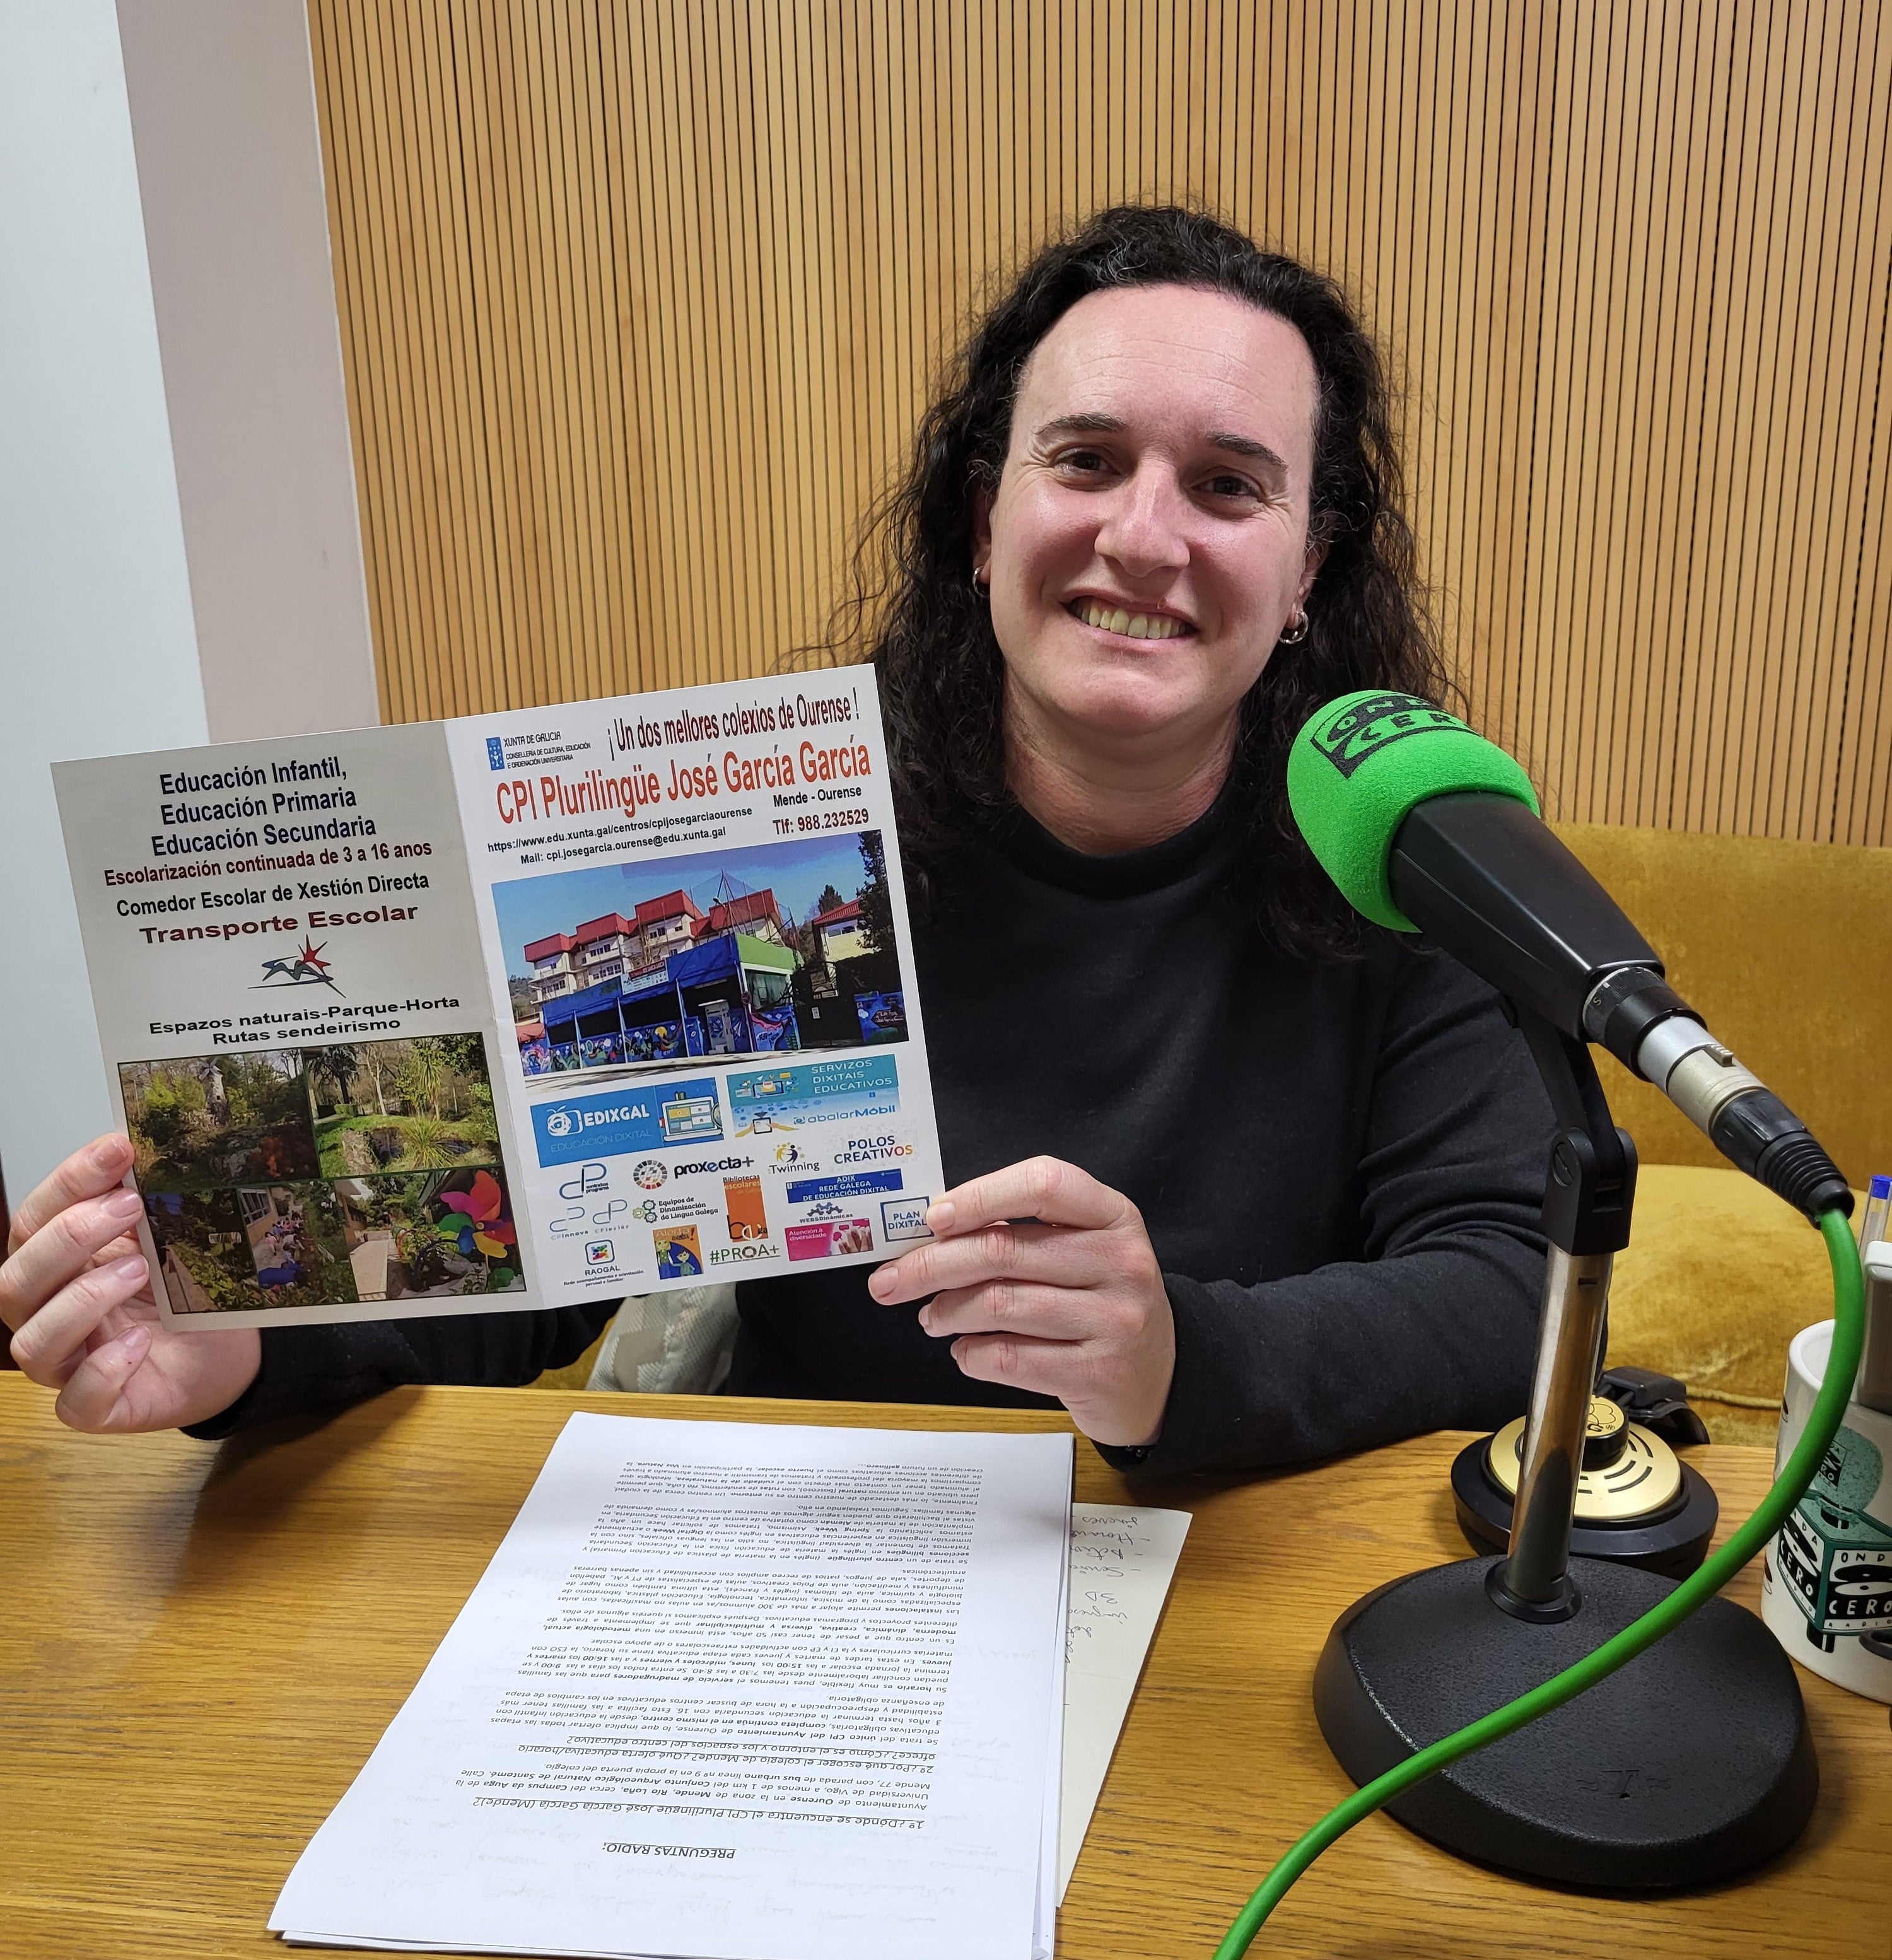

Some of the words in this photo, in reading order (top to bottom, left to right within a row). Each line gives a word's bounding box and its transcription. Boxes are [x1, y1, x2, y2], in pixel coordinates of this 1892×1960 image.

[614, 718, 635, 752] Un
[637, 715, 662, 749] dos
[663, 709, 720, 745] mellores
[722, 700, 776, 737] colexios
[778, 696, 795, 730] de
[797, 694, 851, 727] Ourense
[503, 735, 526, 747] XUNTA
[526, 734, 535, 744] DE
[535, 731, 561, 743] GALICIA
[565, 741, 592, 752] EDUCACIÓN
[160, 765, 267, 795] Educación
[271, 755, 347, 783] Infantil,
[496, 779, 537, 824] CPI
[540, 764, 661, 819] Plurilingüe
[667, 753, 718, 801] José
[723, 744, 796, 793] García
[799, 733, 872, 783] García
[773, 791, 809, 807] Mende
[817, 786, 862, 802] Ourense
[160, 796, 268, 825] Educación
[272, 786, 357, 814] Primaria
[772, 818, 794, 835] Tlf:
[797, 808, 869, 832] 988.232529
[151, 827, 259, 856] Educación
[263, 816, 377, 845] Secundaria
[520, 852, 544, 865] Mail:
[104, 860, 222, 887] Escolarización
[226, 850, 316, 874] continuada
[319, 848, 339, 865] de
[342, 846, 353, 863] 3
[357, 848, 368, 861] a
[371, 843, 390, 860] 16
[394, 843, 432, 858] anos
[117, 894, 196, 917] Comedor
[201, 887, 267, 909] Escolar
[272, 884, 293, 902] de
[296, 878, 363, 900] Xestión
[367, 872, 429, 893] Directa
[139, 915, 298, 944] Transporte
[308, 905, 418, 928] Escolar
[149, 1018, 233, 1035] Espazos
[239, 996, 460, 1027] naturais-Parque-Horta
[213, 1031, 271, 1045] Rutas
[277, 1020, 400, 1039] sendeirismo
[811, 1059, 872, 1074] SERVIZOS
[813, 1071, 864, 1084] DIXITAIS
[814, 1077, 892, 1094] EDUCATIVOS
[584, 1104, 650, 1127] EDIXGAL
[808, 1105, 896, 1123] abalarMóbil
[551, 1135, 613, 1153] EDUCACIÓN
[612, 1129, 651, 1144] DIXITAL
[848, 1135, 896, 1151] POLOS
[834, 1145, 913, 1164] CREATIVOS
[768, 1161, 820, 1174] Twinning
[723, 1174, 760, 1183] Bibliotecas
[836, 1175, 856, 1183] ADIX
[819, 1184, 839, 1193] REDE
[839, 1180, 872, 1189] GALEGA
[814, 1188, 858, 1200] EDUCACIÓN
[860, 1186, 889, 1194] DIXITAL
[658, 1198, 686, 1207] Equipos
[659, 1201, 706, 1213] Dinamización
[893, 1210, 920, 1221] PLAN
[585, 1265, 621, 1276] RAOGAL
[1841, 1552, 1885, 1563] OND
[566, 1735, 628, 1746] educativo?
[631, 1738, 668, 1746] centro
[670, 1739, 688, 1749] del
[691, 1739, 739, 1749] espacios
[761, 1742, 768, 1751] y
[518, 1744, 619, 1757] educativa/horario
[742, 1742, 758, 1753] los
[771, 1744, 816, 1754] entorno
[819, 1747, 830, 1756] el
[849, 1748, 889, 1758] ¿Cómo
[622, 1749, 656, 1759] oferta
[658, 1751, 689, 1760] ¿Qué
[691, 1752, 739, 1763] Mende?
[742, 1754, 757, 1764] de
[760, 1754, 800, 1766] colegio
[892, 1751, 935, 1761] ofrece?
[803, 1758, 814, 1767] el
[817, 1757, 862, 1768] escoger
[865, 1759, 887, 1770] qué
[890, 1763, 917, 1773] ¿Por
[472, 1795, 535, 1809] (Mende)?
[539, 1799, 578, 1811] García
[583, 1801, 622, 1812] García
[626, 1803, 654, 1814] José
[657, 1803, 725, 1817] Plurilingüe
[728, 1808, 749, 1819] CPI
[752, 1810, 764, 1820] el
[768, 1811, 833, 1823] encuentra
[837, 1815, 851, 1824] se
[855, 1816, 905, 1828] ¿Dónde
[602, 1841, 651, 1855] RADIO:
[654, 1845, 735, 1859] PREGUNTAS
